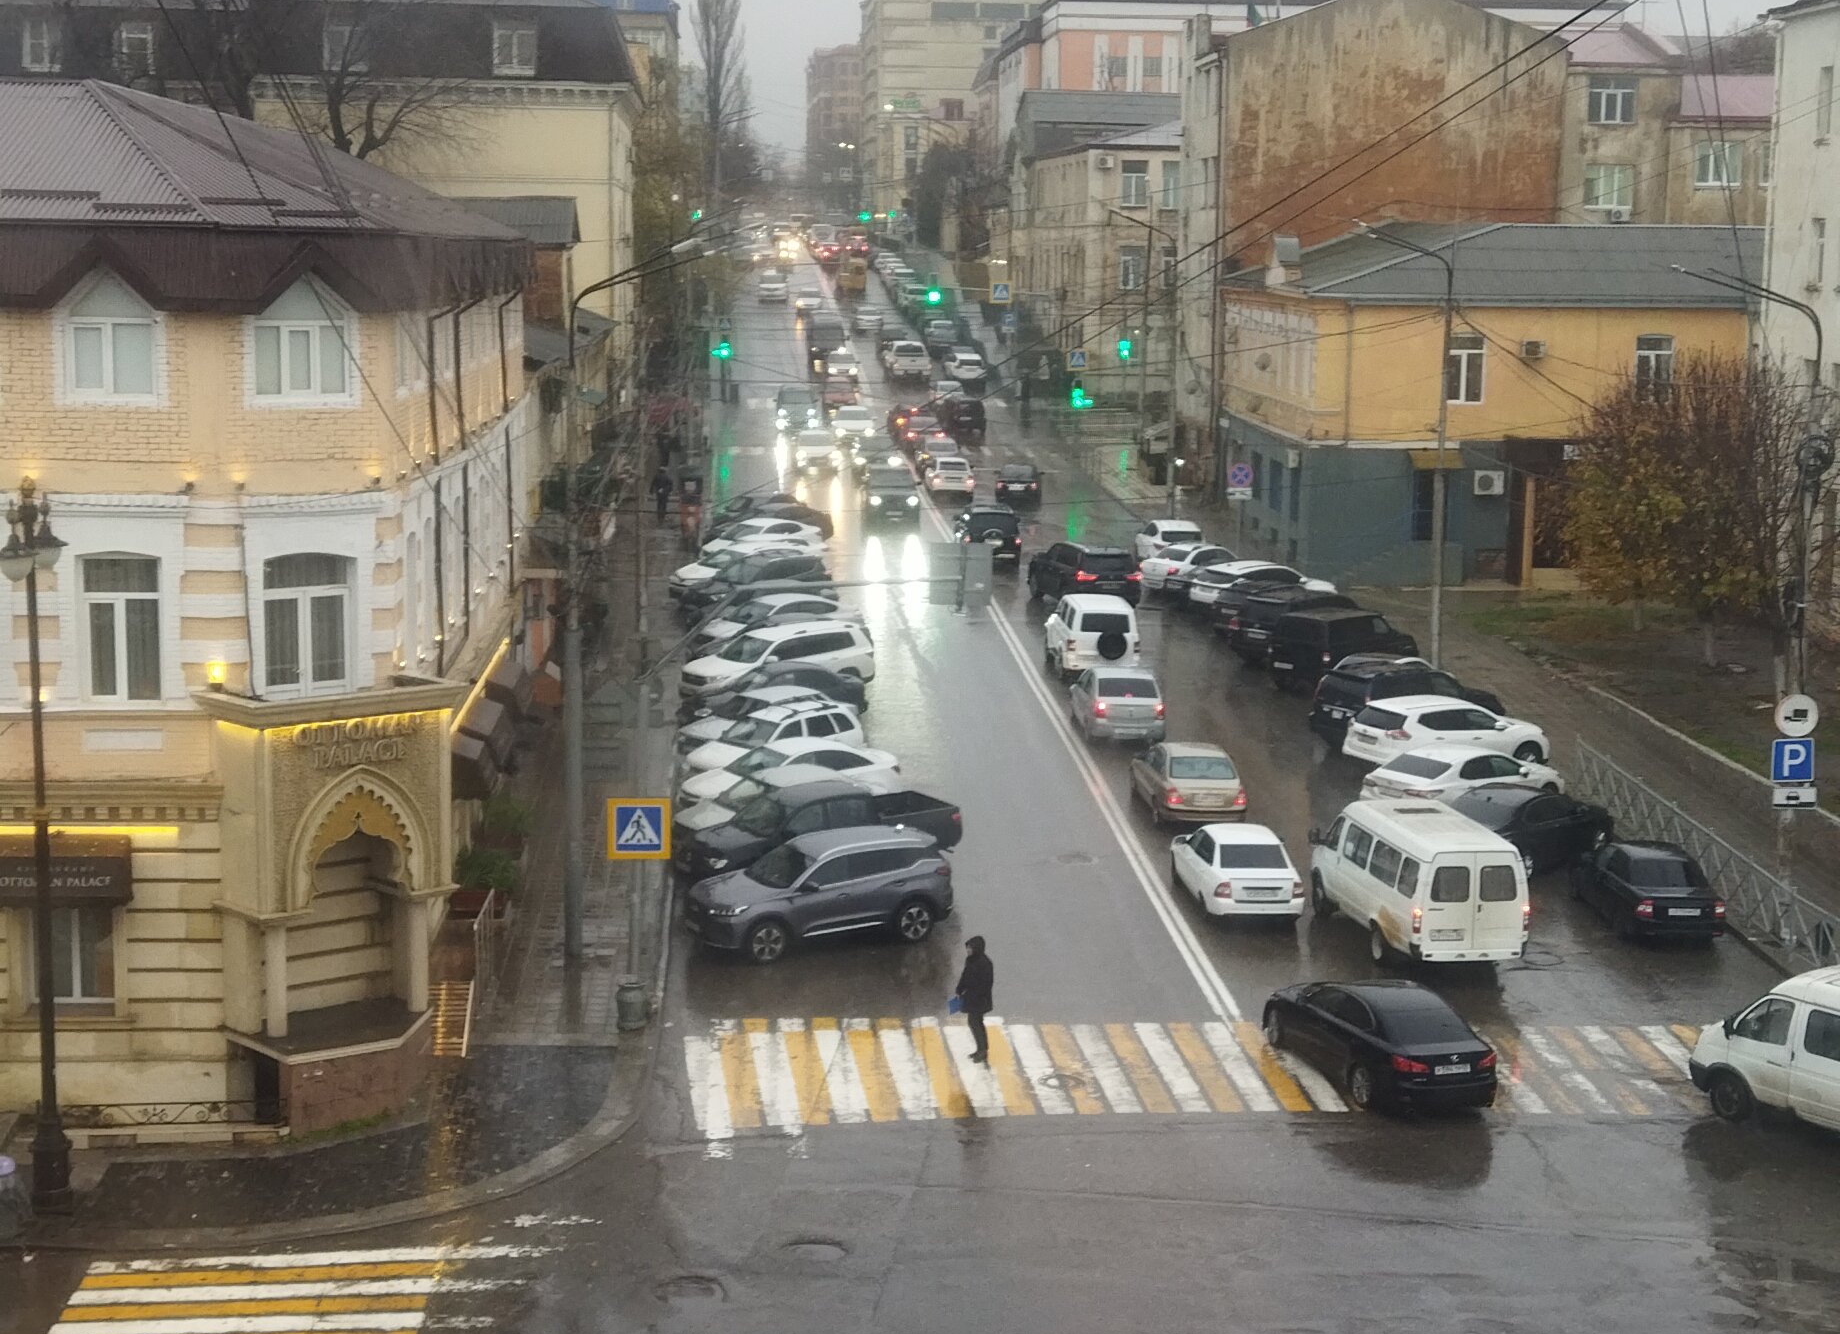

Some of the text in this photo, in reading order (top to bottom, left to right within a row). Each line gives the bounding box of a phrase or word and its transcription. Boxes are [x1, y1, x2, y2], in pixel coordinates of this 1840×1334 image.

[293, 713, 421, 746] OTTOMAN
[313, 737, 408, 768] PALACE
[1782, 744, 1806, 777] P
[67, 876, 111, 887] PALACE
